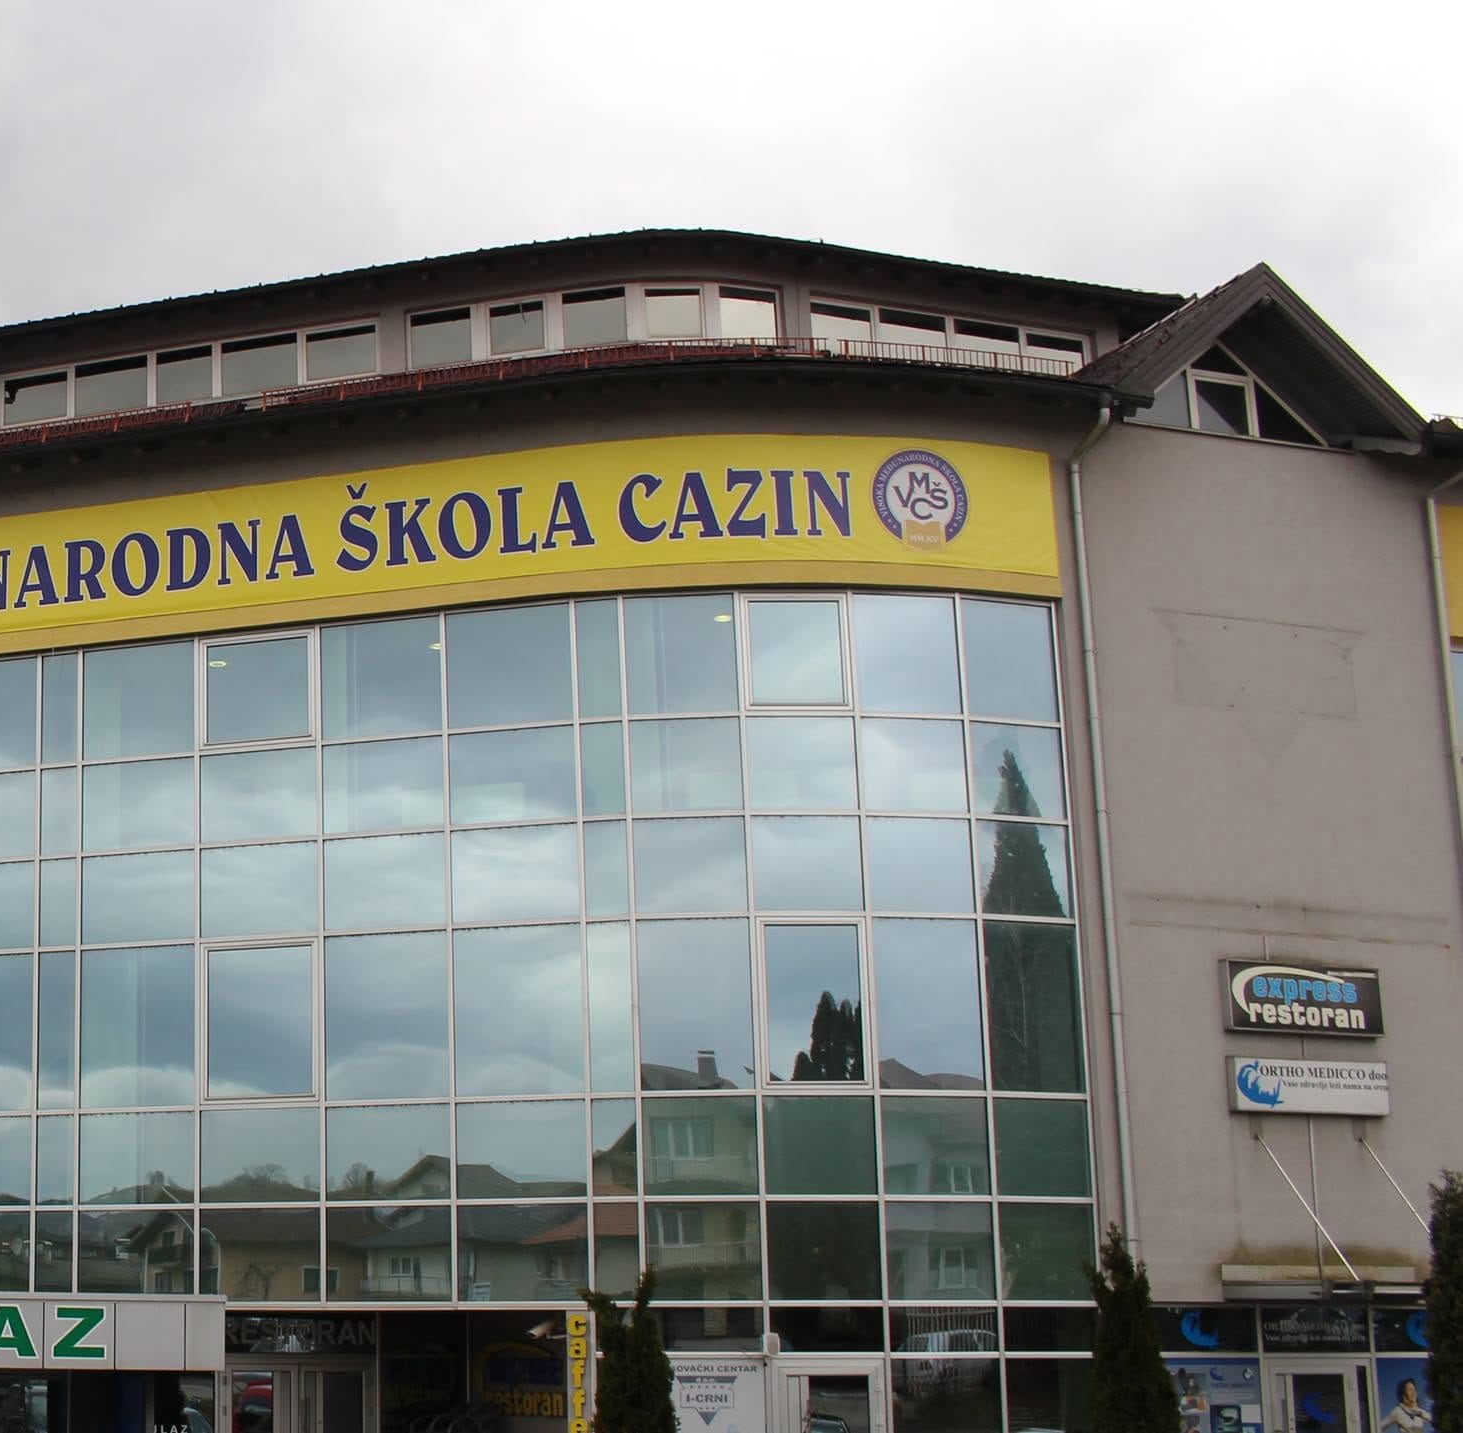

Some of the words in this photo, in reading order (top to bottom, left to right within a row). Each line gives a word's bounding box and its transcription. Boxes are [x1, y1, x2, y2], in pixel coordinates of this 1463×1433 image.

[336, 482, 596, 572] ŠKOLA
[618, 467, 852, 544] CAZIN
[1252, 977, 1358, 1005] express
[1248, 1002, 1366, 1029] restoran
[1260, 1065, 1304, 1078] ORTHO
[1307, 1067, 1366, 1080] MEDICCO
[717, 1365, 758, 1373] CENTAR
